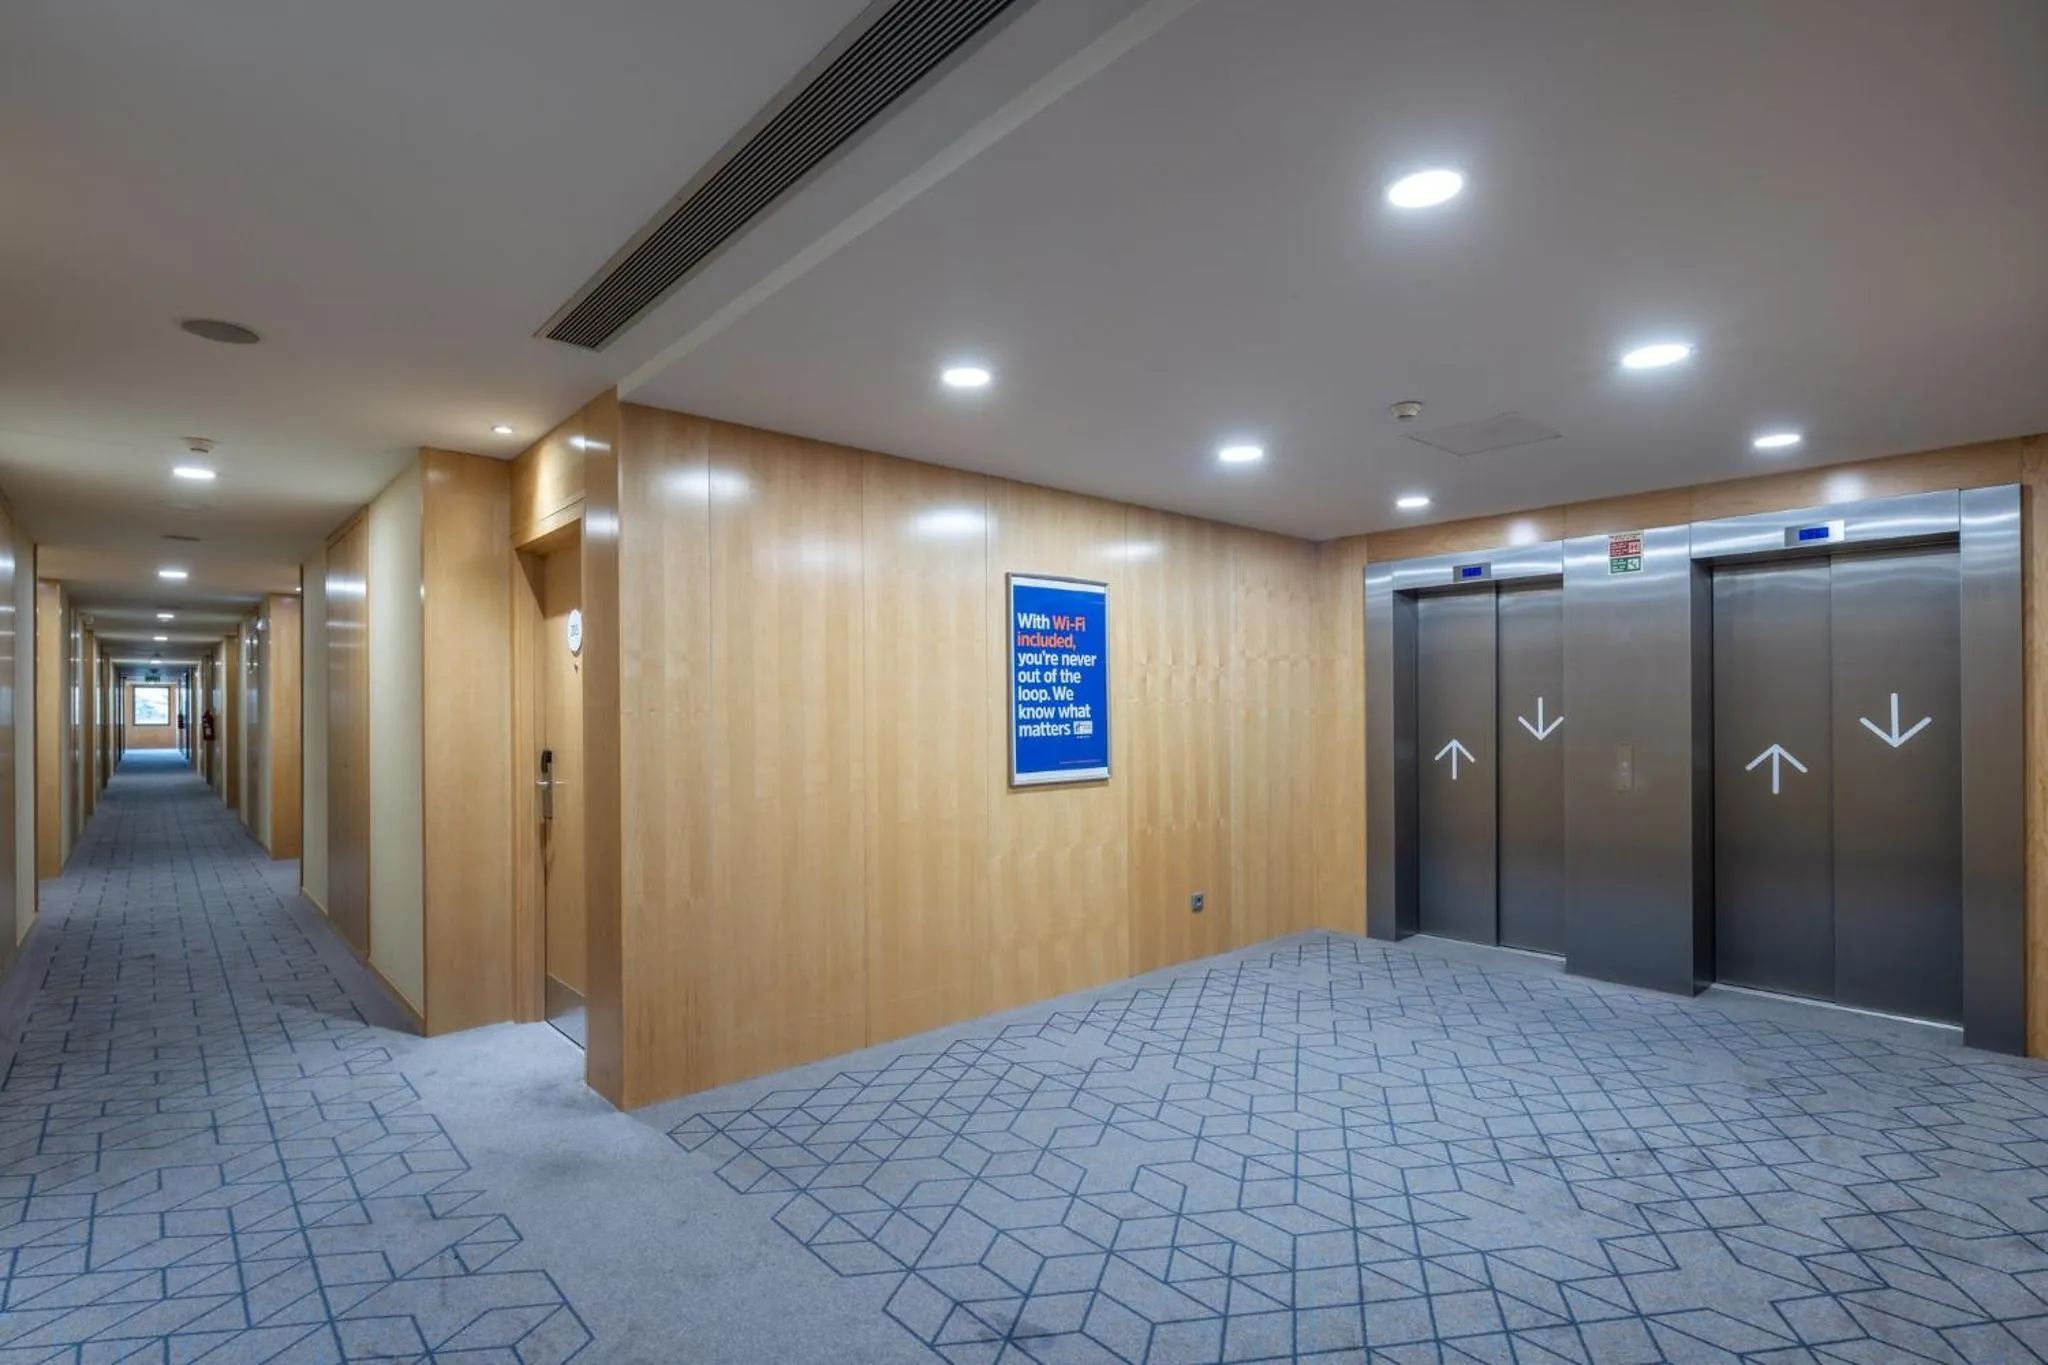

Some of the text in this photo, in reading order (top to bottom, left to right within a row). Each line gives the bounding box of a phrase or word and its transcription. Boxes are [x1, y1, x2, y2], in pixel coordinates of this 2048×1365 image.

[1017, 612, 1086, 632] With Wi-Fi
[1017, 631, 1076, 651] included,
[1018, 650, 1097, 667] you're never
[1018, 668, 1081, 684] out of the
[1018, 686, 1074, 703] loop. We
[1018, 703, 1091, 719] know what
[1019, 721, 1071, 737] matters
